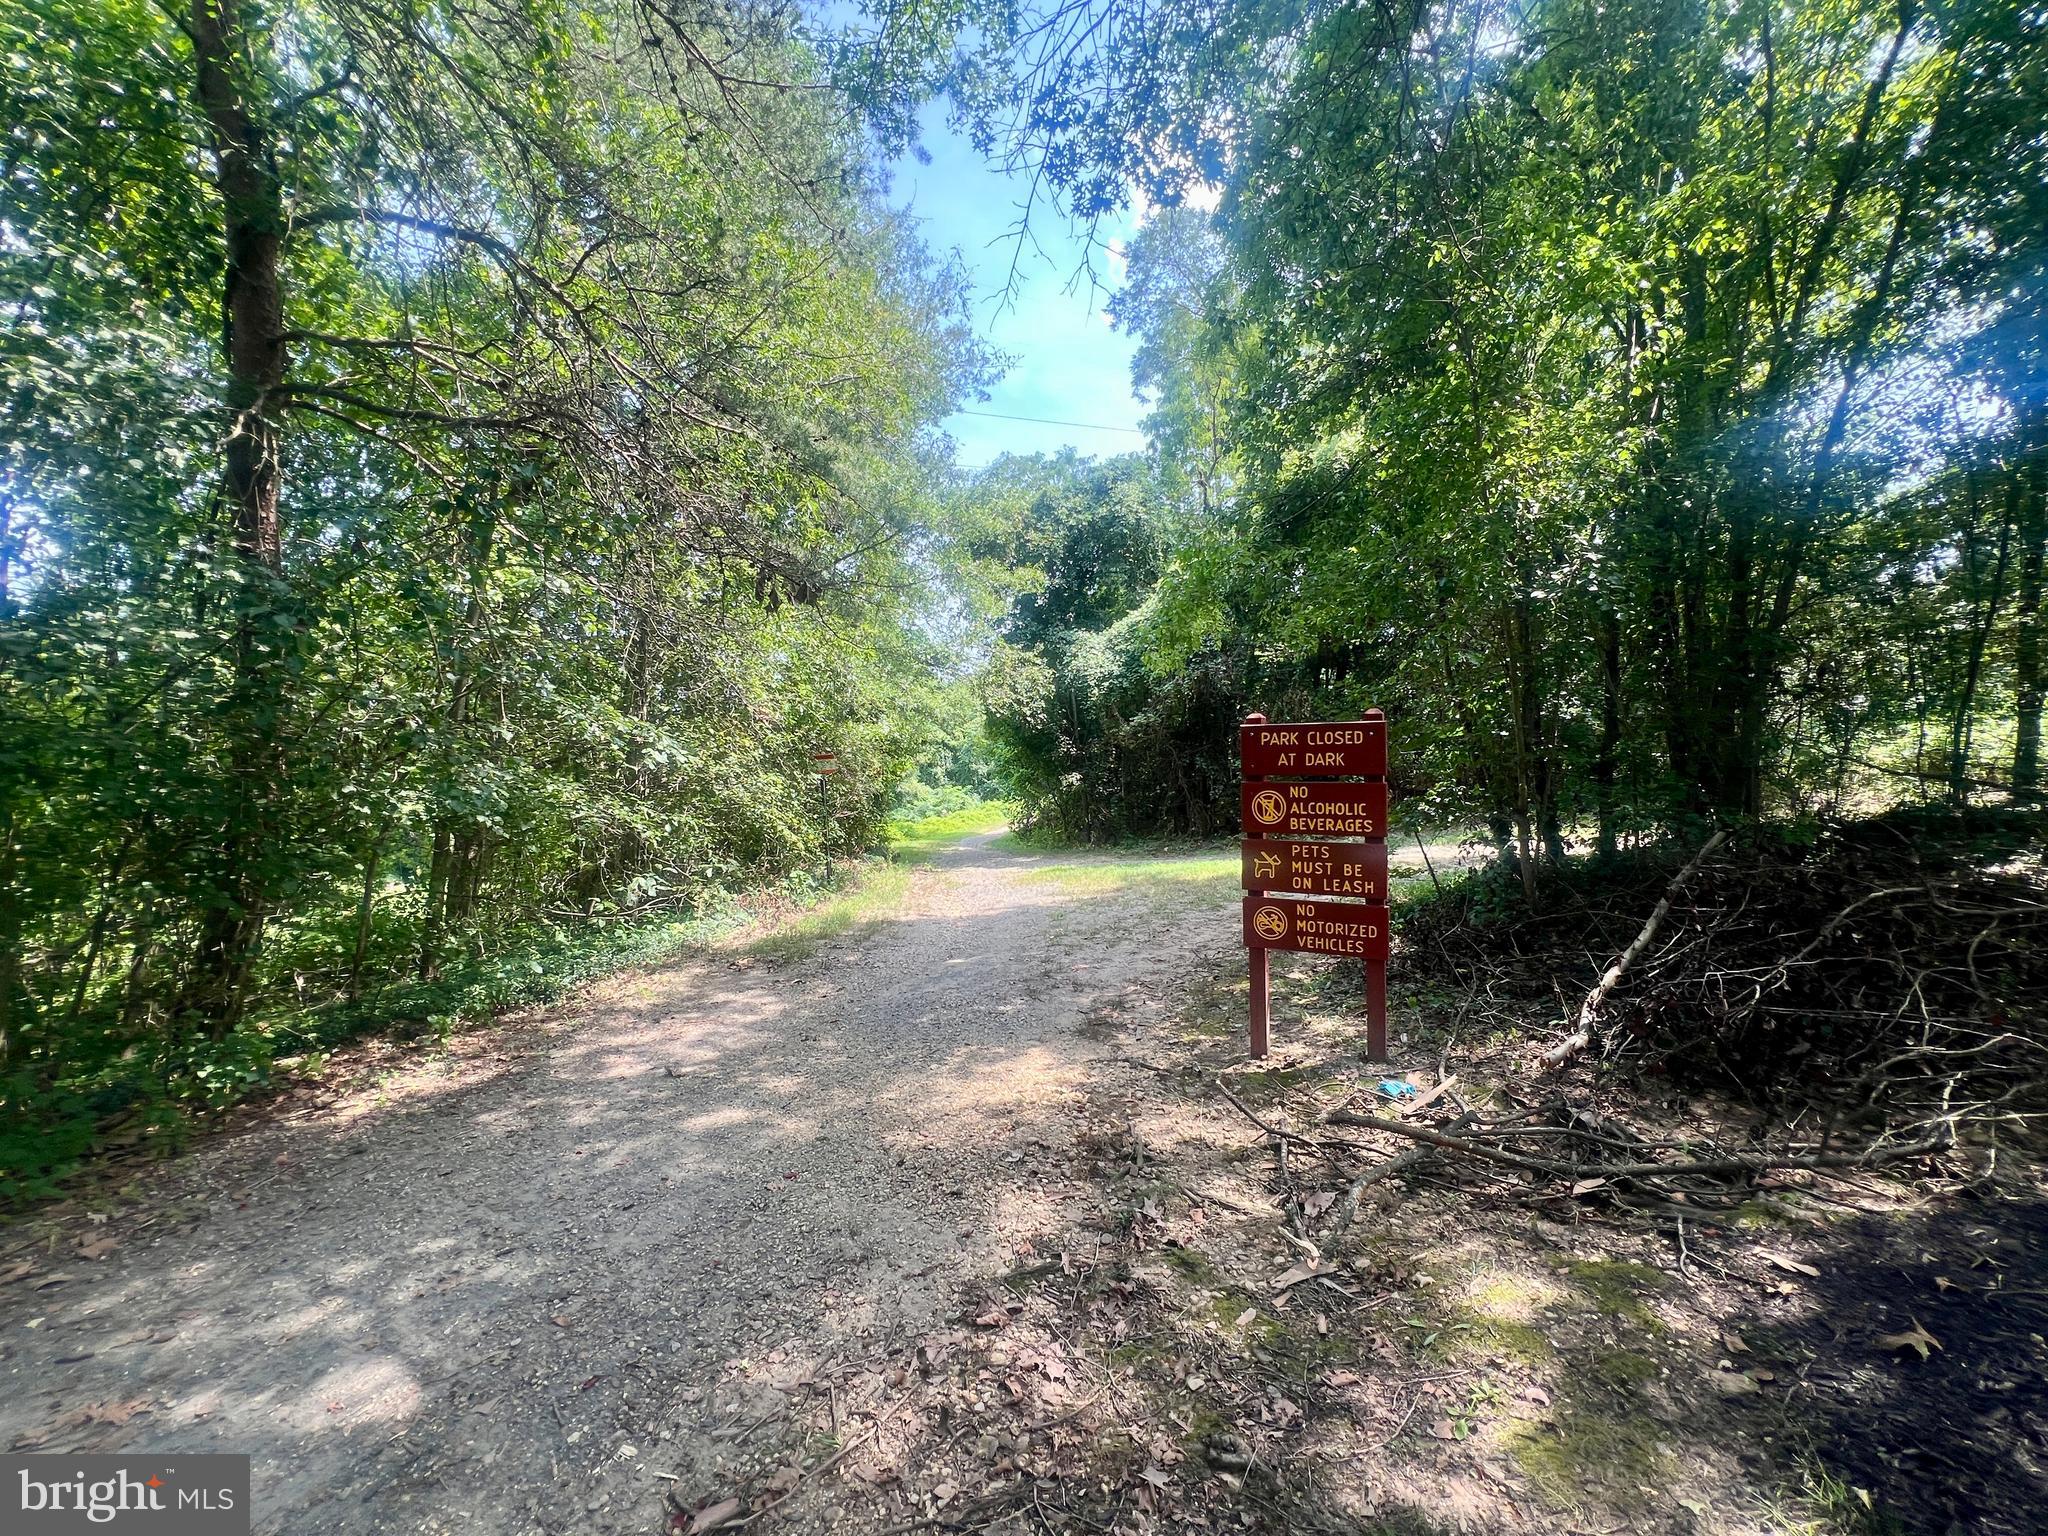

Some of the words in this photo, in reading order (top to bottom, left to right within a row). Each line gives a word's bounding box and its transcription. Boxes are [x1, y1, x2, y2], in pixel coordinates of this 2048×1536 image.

[1260, 731, 1299, 746] PARK
[1307, 730, 1364, 746] CLOSED
[1277, 752, 1297, 767] AT
[1305, 752, 1345, 767] DARK
[1289, 786, 1308, 799] NO
[1290, 802, 1367, 816] ALCOHOLIC
[1290, 817, 1373, 833] BEVERAGES
[1291, 844, 1330, 859] PETS
[1291, 861, 1333, 875] MUST
[1343, 863, 1363, 877] BE
[1292, 876, 1312, 890] ON
[1323, 878, 1374, 894] LEASH
[1296, 904, 1315, 917] NO
[1296, 919, 1378, 938] MOTORIZED
[1297, 935, 1365, 953] VEHICLES
